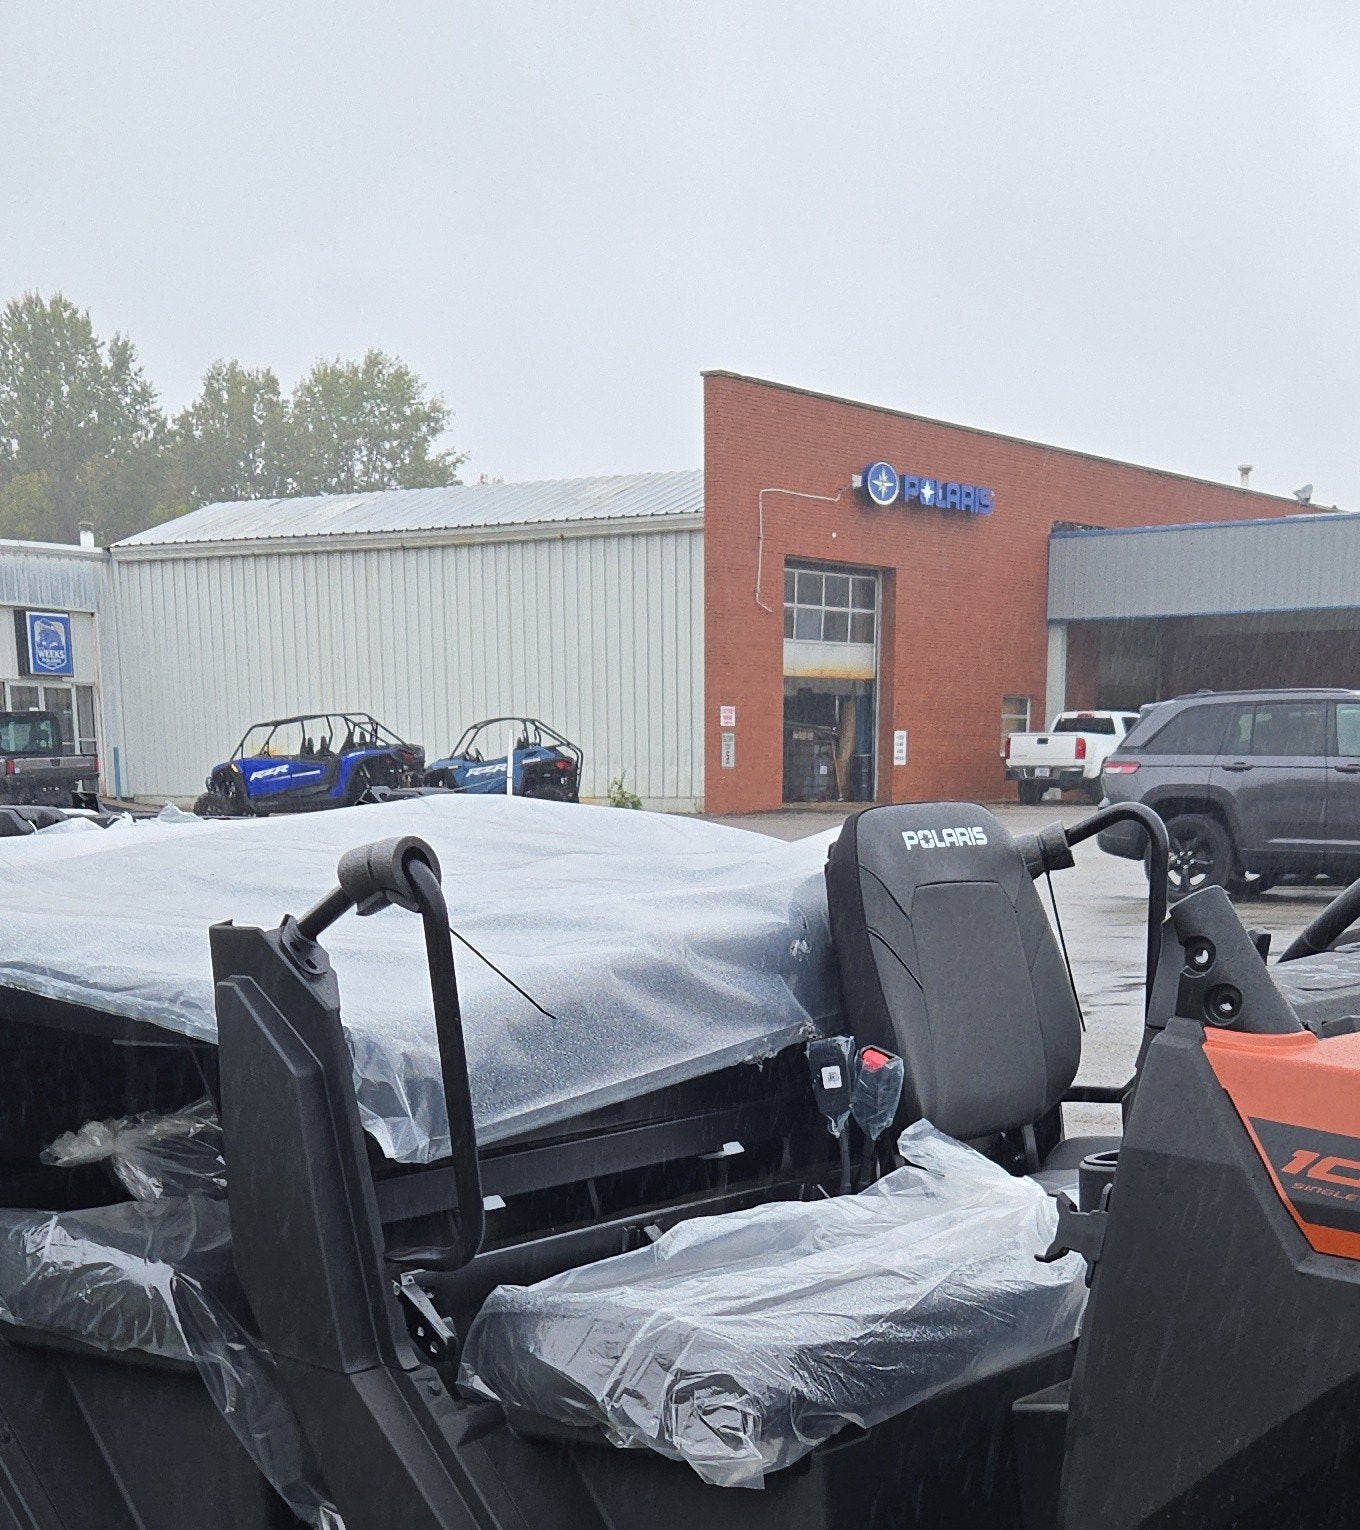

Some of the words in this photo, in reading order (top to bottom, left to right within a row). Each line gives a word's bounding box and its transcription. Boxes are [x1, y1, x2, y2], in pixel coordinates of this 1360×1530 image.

[904, 474, 994, 516] POLARIS
[250, 764, 290, 782] RZR
[465, 763, 508, 778] RZR
[901, 826, 988, 850] POLARIS
[1292, 1181, 1359, 1202] SINGLE
